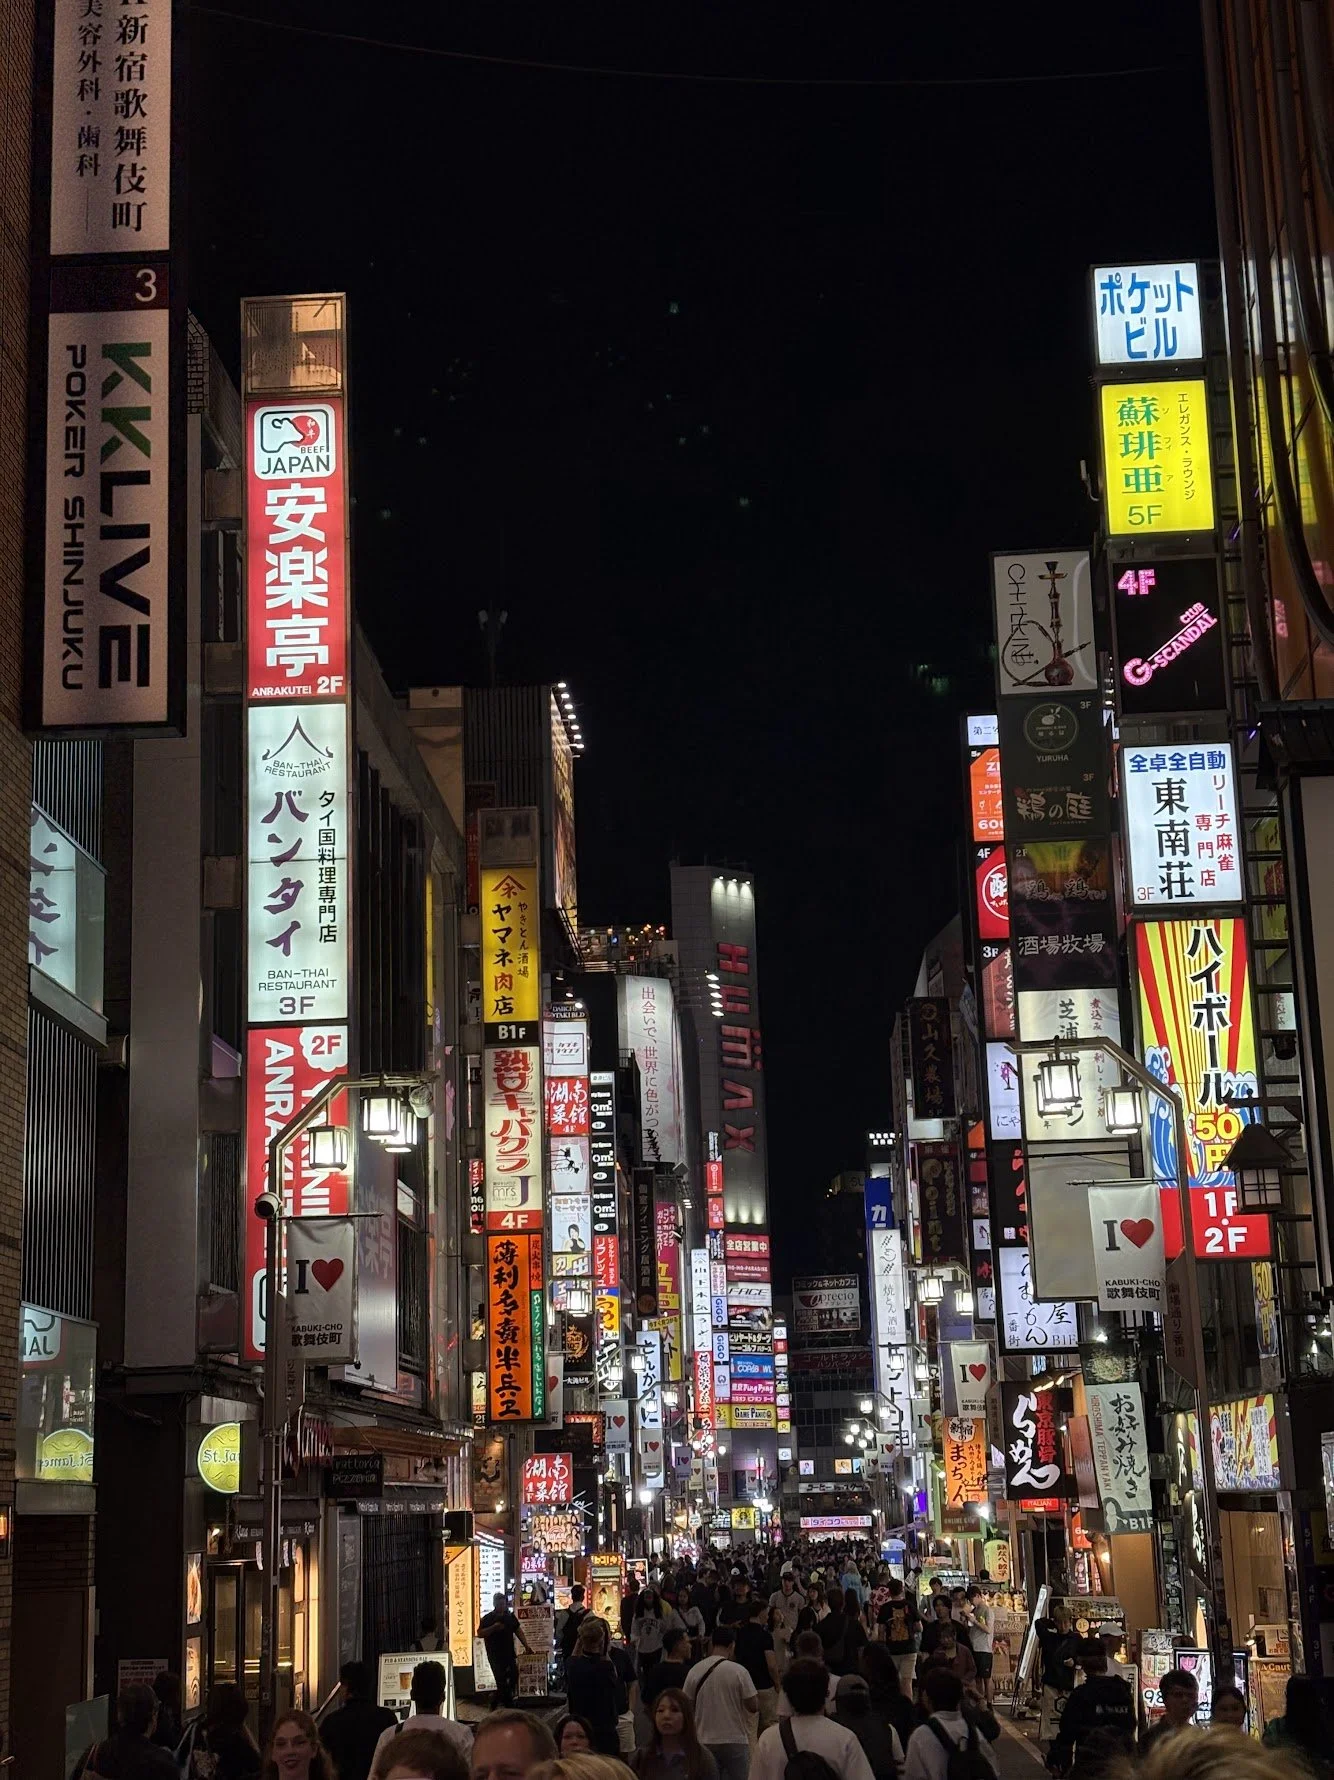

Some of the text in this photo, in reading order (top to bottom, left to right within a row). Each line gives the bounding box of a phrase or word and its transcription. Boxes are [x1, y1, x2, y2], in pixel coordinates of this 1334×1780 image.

[113, 0, 149, 232] 新宿歌舞伎町
[135, 268, 157, 302] 3
[1100, 270, 1195, 316] ポケット
[1124, 317, 1178, 359] ビル
[300, 446, 325, 454] BEEF
[1177, 393, 1195, 501] エレガンス・ラウンジ
[261, 455, 330, 475] JAPAN
[61, 345, 87, 690] POKER SHINJUKU
[98, 342, 152, 688] KKLIVE
[1127, 504, 1163, 526] 5F
[265, 483, 329, 677] 安楽亭
[1117, 568, 1156, 596] 4F
[1180, 602, 1205, 624] CLUB
[1123, 614, 1218, 686] G-SCANDAL
[252, 686, 312, 696] ANRAKUTEI
[317, 676, 343, 694] 2F
[1080, 701, 1092, 709] 3F
[264, 762, 332, 779] RESTAURANT
[272, 758, 324, 770] BAN-THAI
[1036, 754, 1069, 763] YURUHA
[1128, 750, 1226, 773] 全卓全自動
[1212, 774, 1236, 872] リーチ麻雀
[1151, 777, 1195, 900] 東南荘
[1194, 813, 1216, 887] 専門店
[977, 848, 991, 859] 4F
[260, 790, 310, 957] バンタイ
[317, 790, 338, 943] タイ国料理専門店
[1137, 887, 1155, 901] 3F
[516, 901, 530, 979] やきとん酒場
[1018, 933, 1106, 956] 酒場牧場
[491, 903, 515, 1017] ヤマネ肉店
[982, 946, 999, 959] 3F
[258, 979, 338, 991] RESTAURANT
[267, 970, 329, 980] BAN-THAI
[279, 997, 315, 1015] 3F
[1185, 927, 1233, 1108] ハイボール
[498, 1024, 526, 1040] B1F
[311, 1034, 341, 1055] 2F
[717, 943, 760, 1152] HUMAX
[641, 986, 659, 1134] 出会いで、世界に色がつ
[551, 1080, 588, 1104] 湖南
[1194, 1114, 1240, 1141] 50
[500, 1212, 529, 1229] 4F
[1103, 1220, 1121, 1252] I
[1204, 1227, 1247, 1253] 2F
[294, 1259, 310, 1294] I
[793, 1278, 857, 1289] コミック&ネットカフェ
[1105, 1278, 1161, 1288] KABUKI-CHO
[1106, 1287, 1160, 1301] 歌舞伎町
[1047, 1303, 1073, 1325] 屋
[291, 1332, 343, 1347] 歌舞伎町
[1007, 1312, 1021, 1347] 一番街
[959, 1364, 969, 1384] I
[1090, 1394, 1103, 1437] HIROSHIMA
[1108, 1392, 1147, 1500] お好み焼き
[525, 1455, 569, 1480] 湖南
[536, 1481, 569, 1502] 菜館
[1129, 1516, 1154, 1530] B1F
[455, 1600, 465, 1635] やきとん
